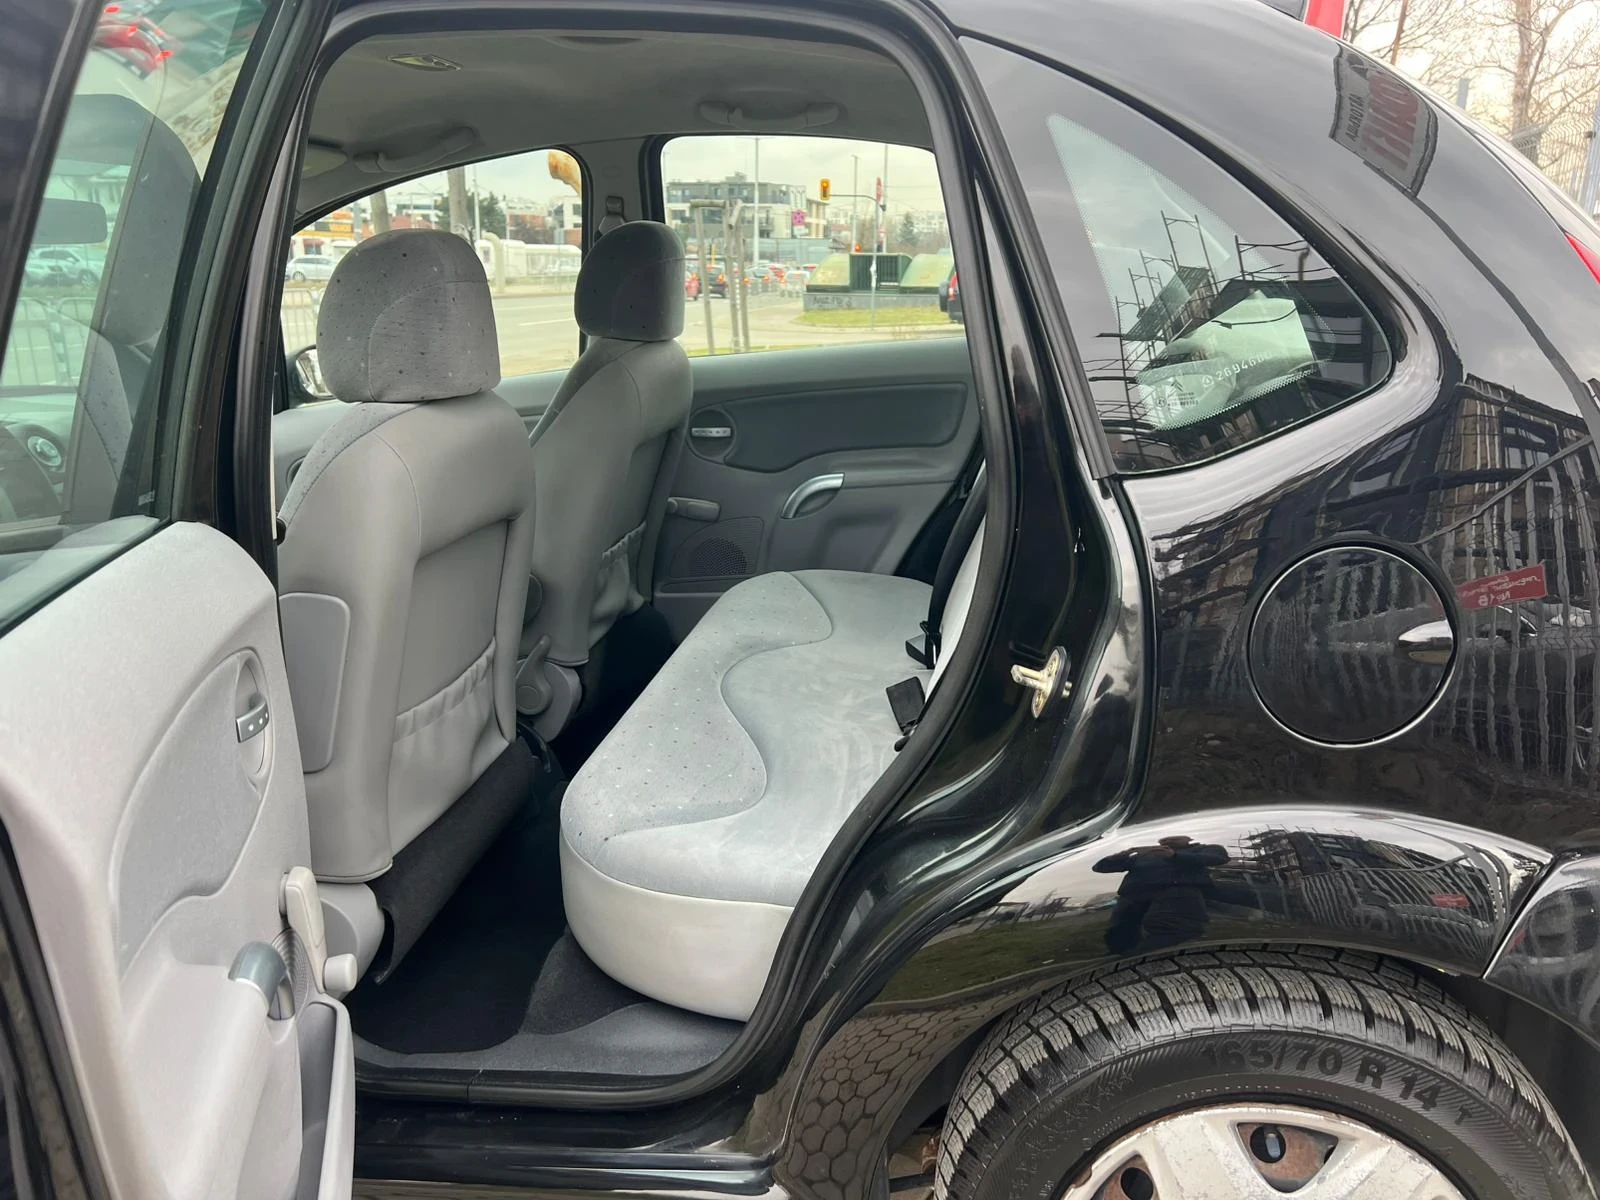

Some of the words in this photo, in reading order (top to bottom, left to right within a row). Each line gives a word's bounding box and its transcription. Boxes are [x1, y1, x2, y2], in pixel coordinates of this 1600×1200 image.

[1202, 1038, 1344, 1076] 165/70
[1355, 1055, 1387, 1089] R
[1399, 1072, 1443, 1112] 14
